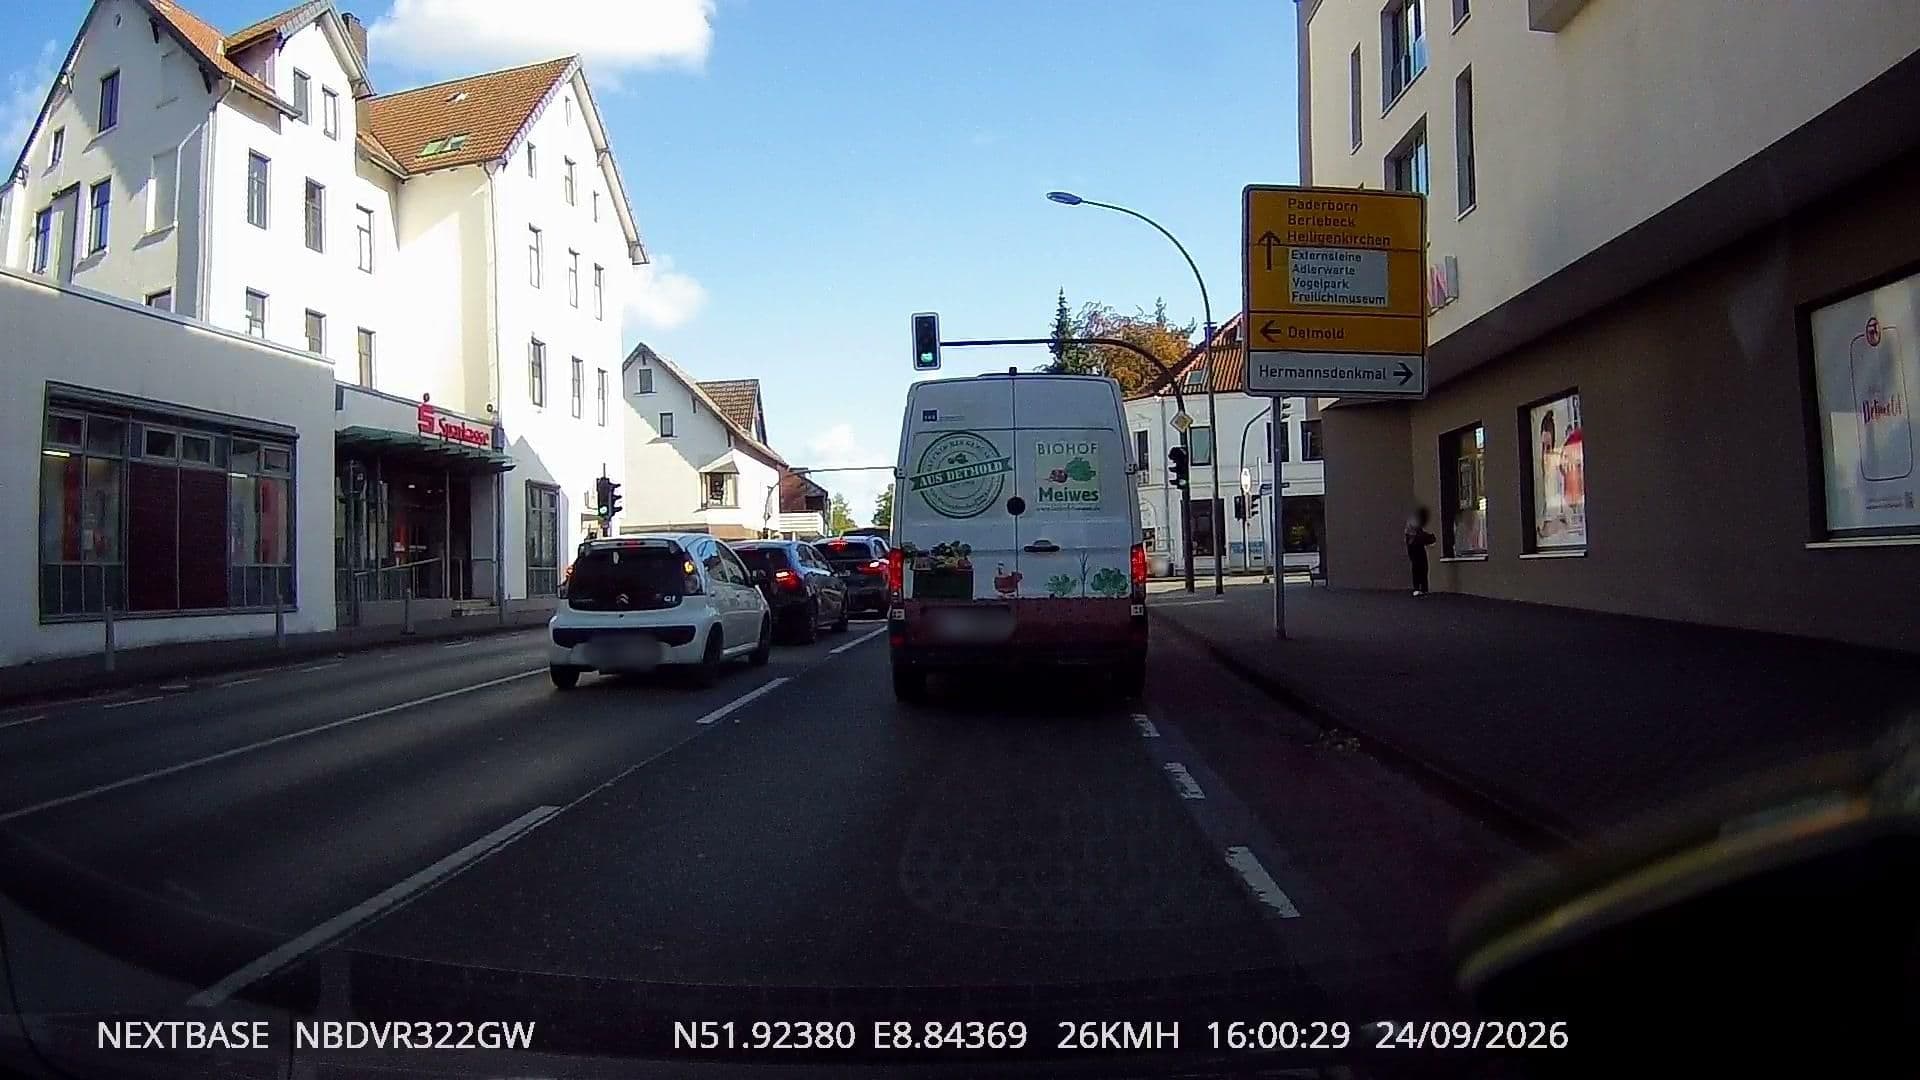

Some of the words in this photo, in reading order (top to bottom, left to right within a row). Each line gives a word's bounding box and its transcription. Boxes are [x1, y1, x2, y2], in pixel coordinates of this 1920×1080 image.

[1288, 198, 1358, 212] Paderborn
[1288, 214, 1356, 228] Berlebeck
[1287, 231, 1391, 246] Heiligenkirchen
[1291, 250, 1362, 263] Externsteine
[1292, 264, 1355, 275] Adlerwarte
[1292, 278, 1350, 291] Vogelpark
[1291, 292, 1386, 305] Freilichtmuseum
[1288, 326, 1345, 339] Detmold
[1259, 365, 1387, 380] Hermannsdenkmal
[439, 417, 490, 446] Sparkasse
[1037, 443, 1097, 455] BIOHOF
[920, 474, 943, 487] AUS
[946, 461, 1003, 481] DETMOLD
[1038, 486, 1099, 502] Meiwes
